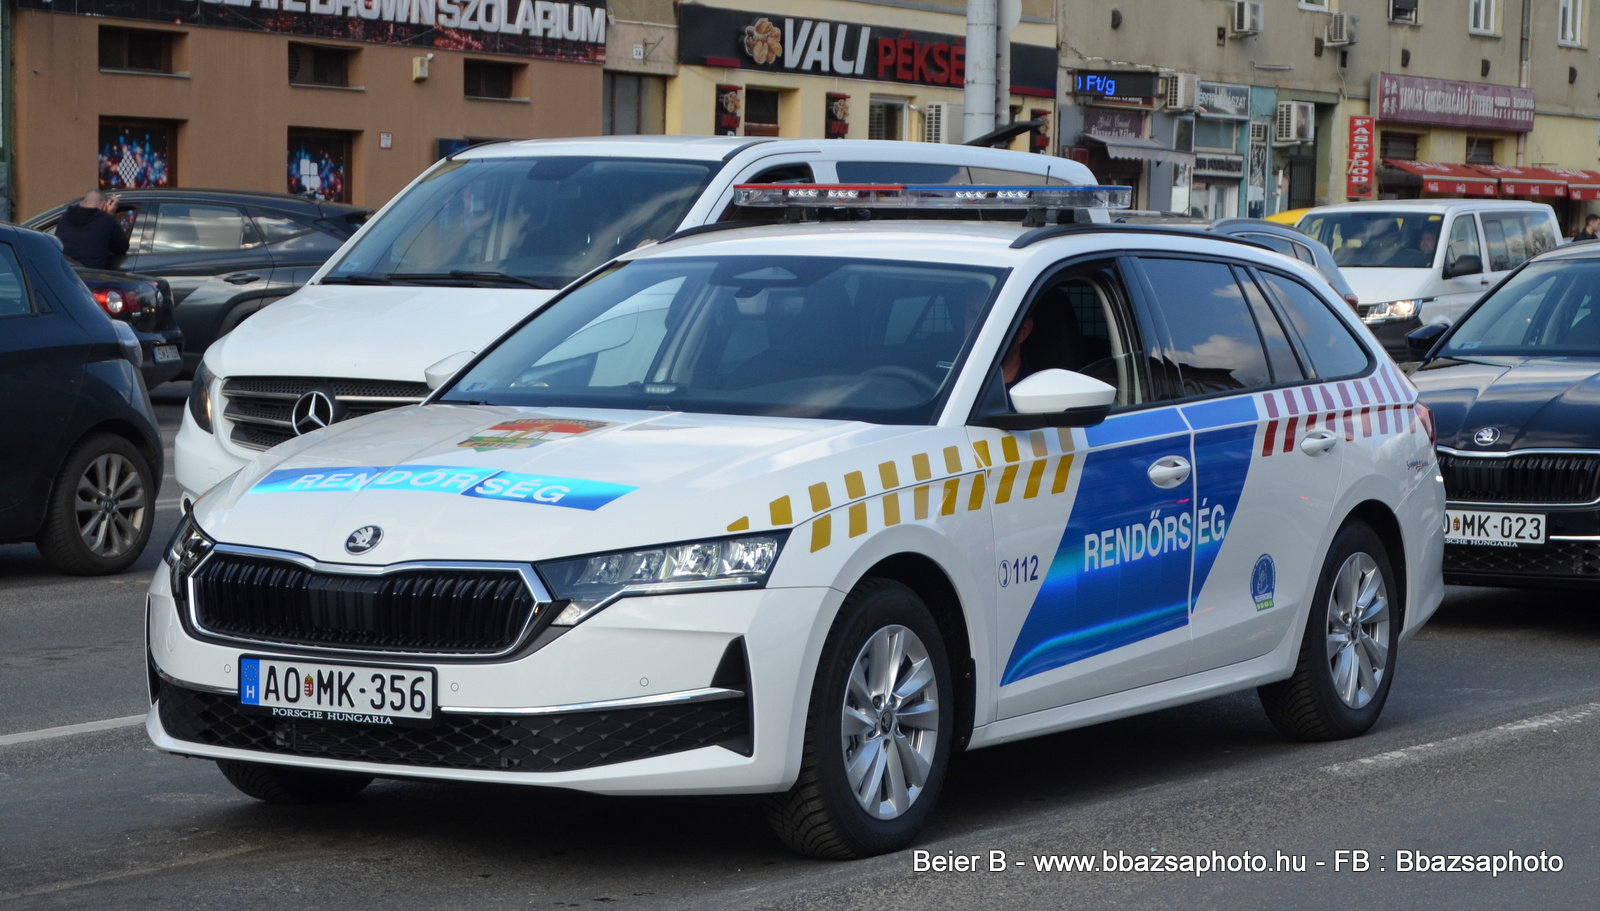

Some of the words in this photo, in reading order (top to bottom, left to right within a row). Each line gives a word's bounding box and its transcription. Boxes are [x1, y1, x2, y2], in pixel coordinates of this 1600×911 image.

[784, 18, 871, 75] VALI
[1086, 75, 1116, 95] Ft/g
[287, 468, 570, 503] RENDŐRSÉG
[1084, 498, 1225, 572] RENDŐRSÉG
[1462, 514, 1541, 540] MK-023
[1470, 538, 1518, 548] HUNGARIA
[1013, 555, 1039, 584] 112
[246, 685, 255, 699] H
[316, 669, 426, 713] MK-356
[272, 707, 323, 719] PORSCHE
[327, 712, 393, 725] HUNGARIA
